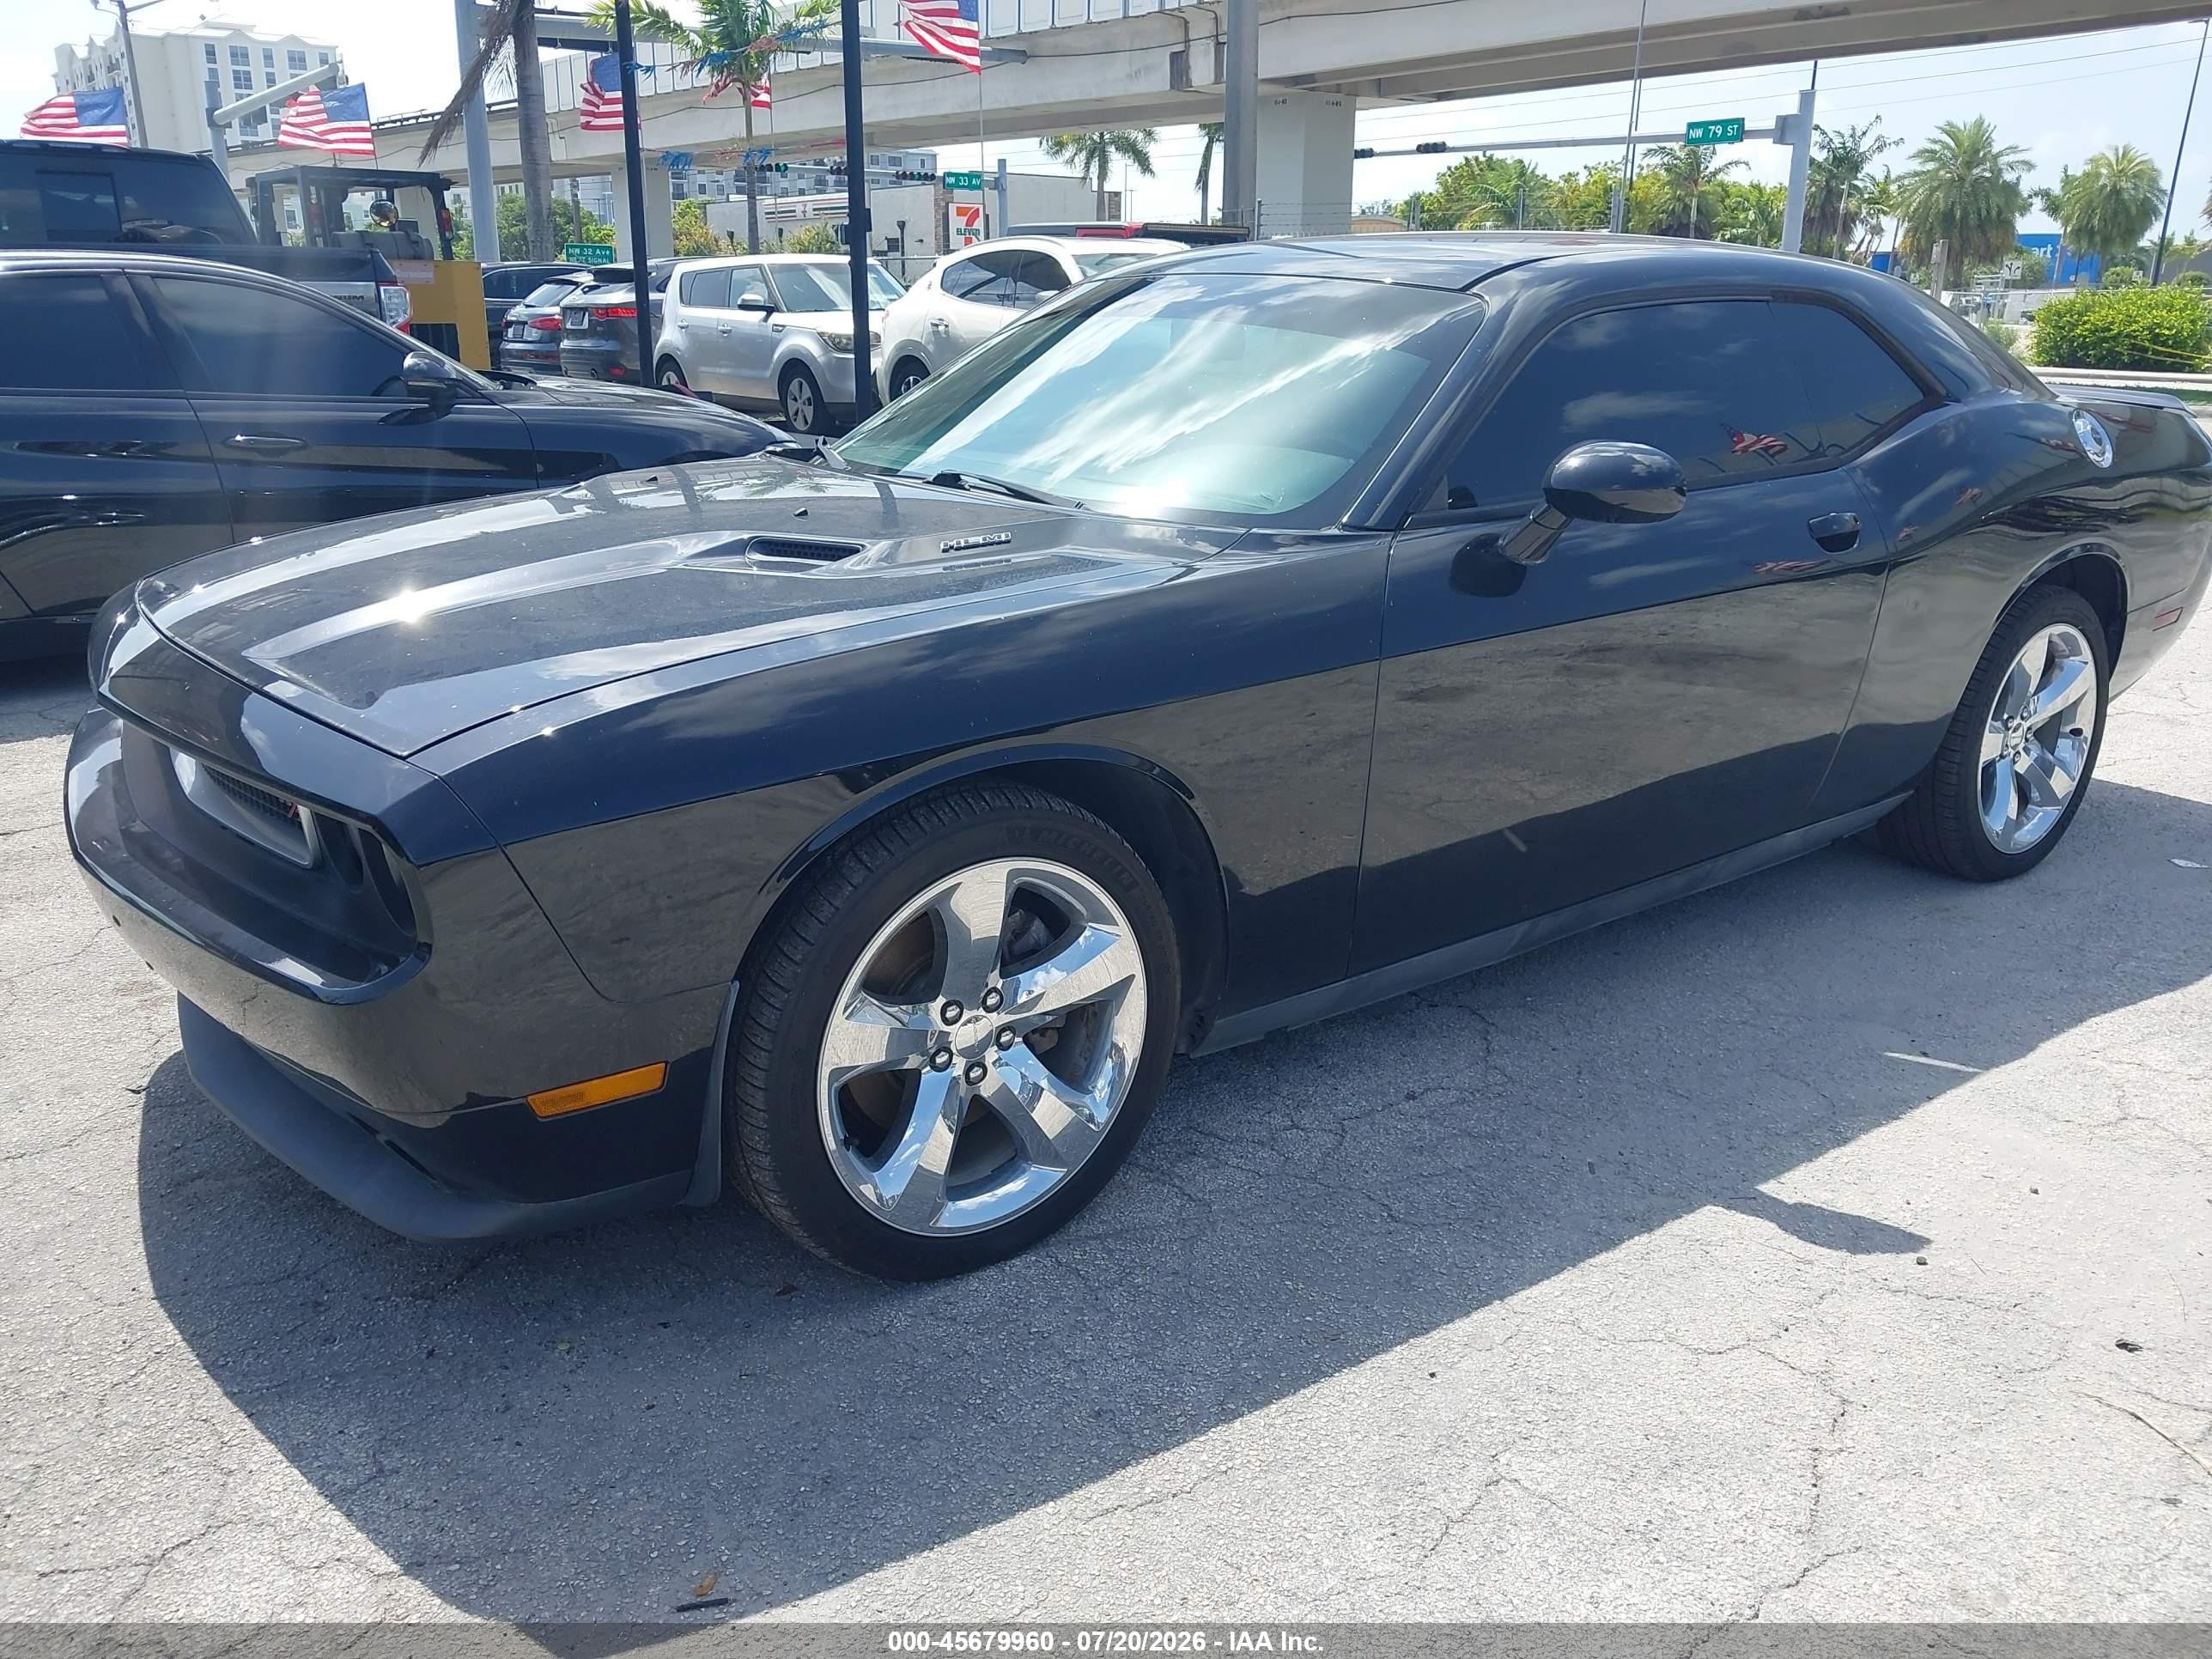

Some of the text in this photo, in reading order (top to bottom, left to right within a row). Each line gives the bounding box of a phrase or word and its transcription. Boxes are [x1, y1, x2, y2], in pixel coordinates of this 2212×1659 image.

[1689, 125, 1738, 139] NW 79 ST
[959, 177, 969, 185] 33
[956, 206, 980, 246] 7
[940, 532, 1012, 552] HEMI
